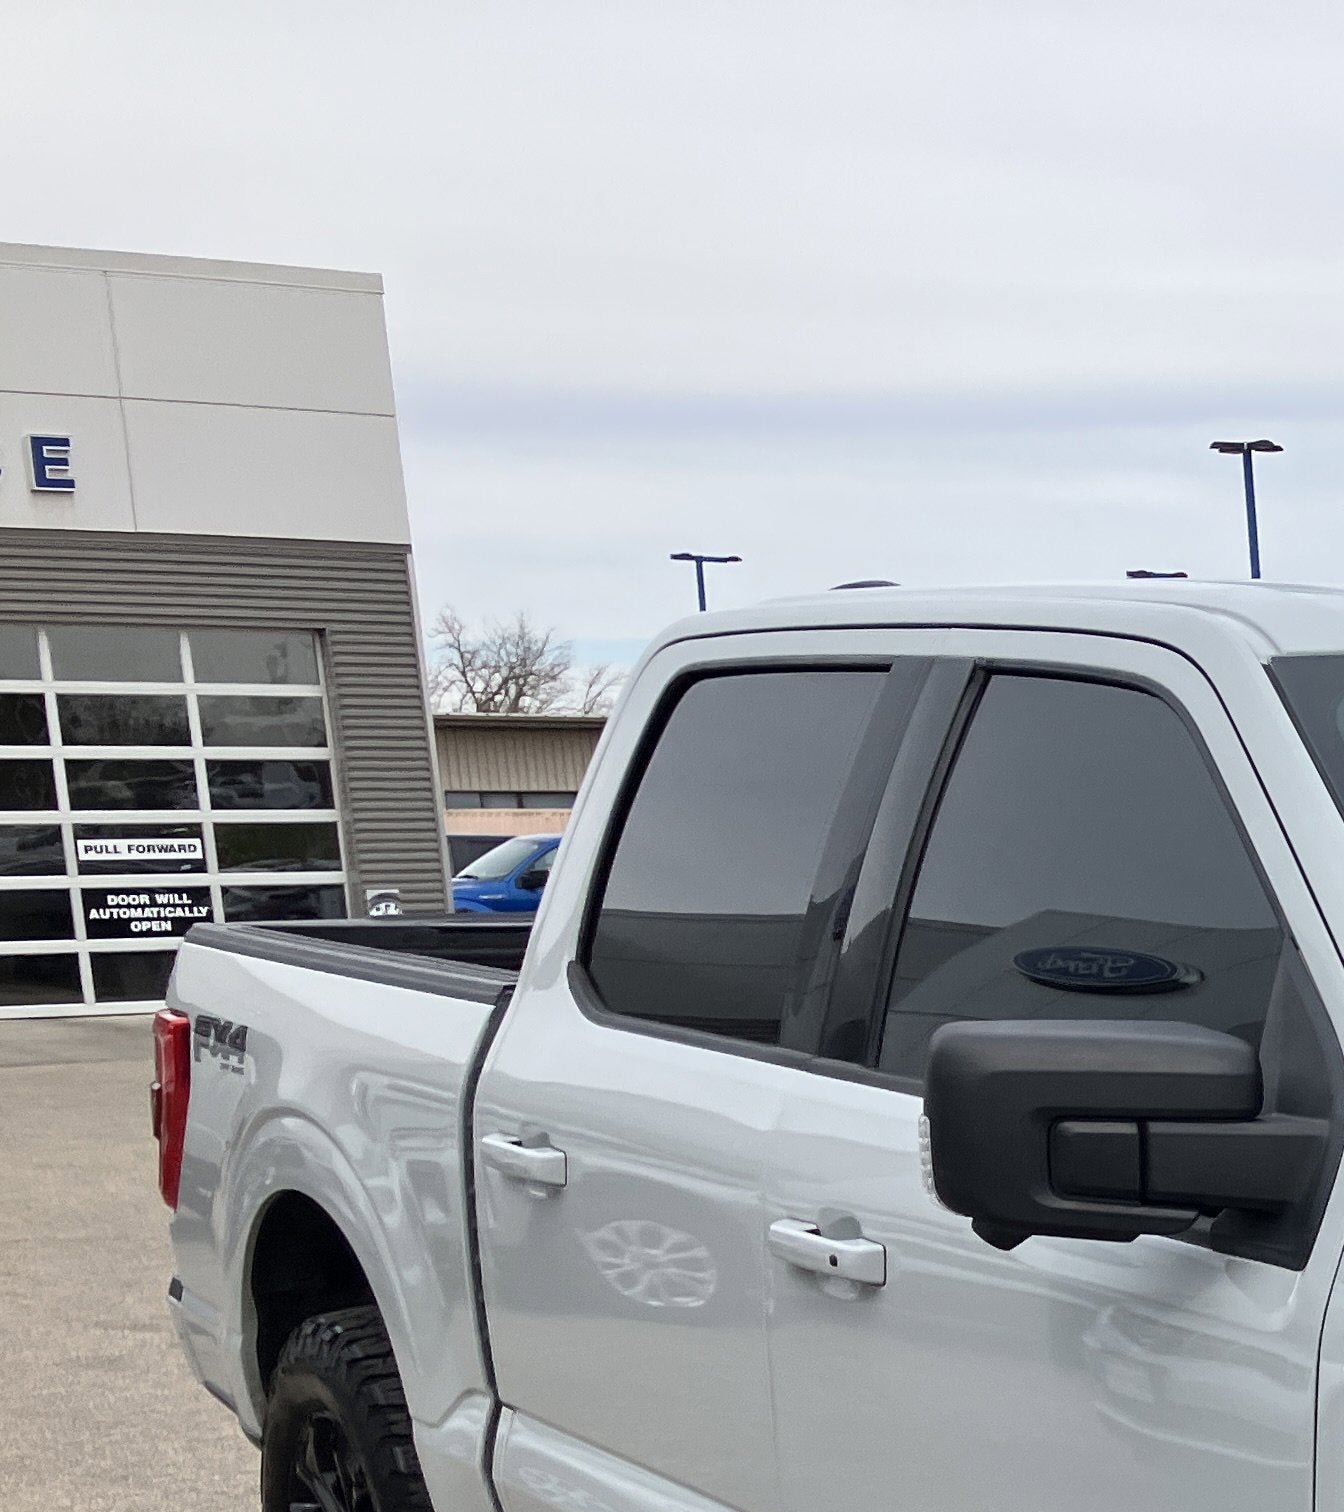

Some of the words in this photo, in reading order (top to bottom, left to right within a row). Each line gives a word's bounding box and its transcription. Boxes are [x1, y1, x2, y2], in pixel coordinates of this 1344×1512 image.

[84, 845, 121, 854] PULL
[128, 844, 197, 853] FORWARD
[107, 895, 149, 905] DOOR
[154, 893, 192, 904] WILL
[89, 906, 208, 919] AUTOMATICALLY
[130, 921, 171, 931] OPEN
